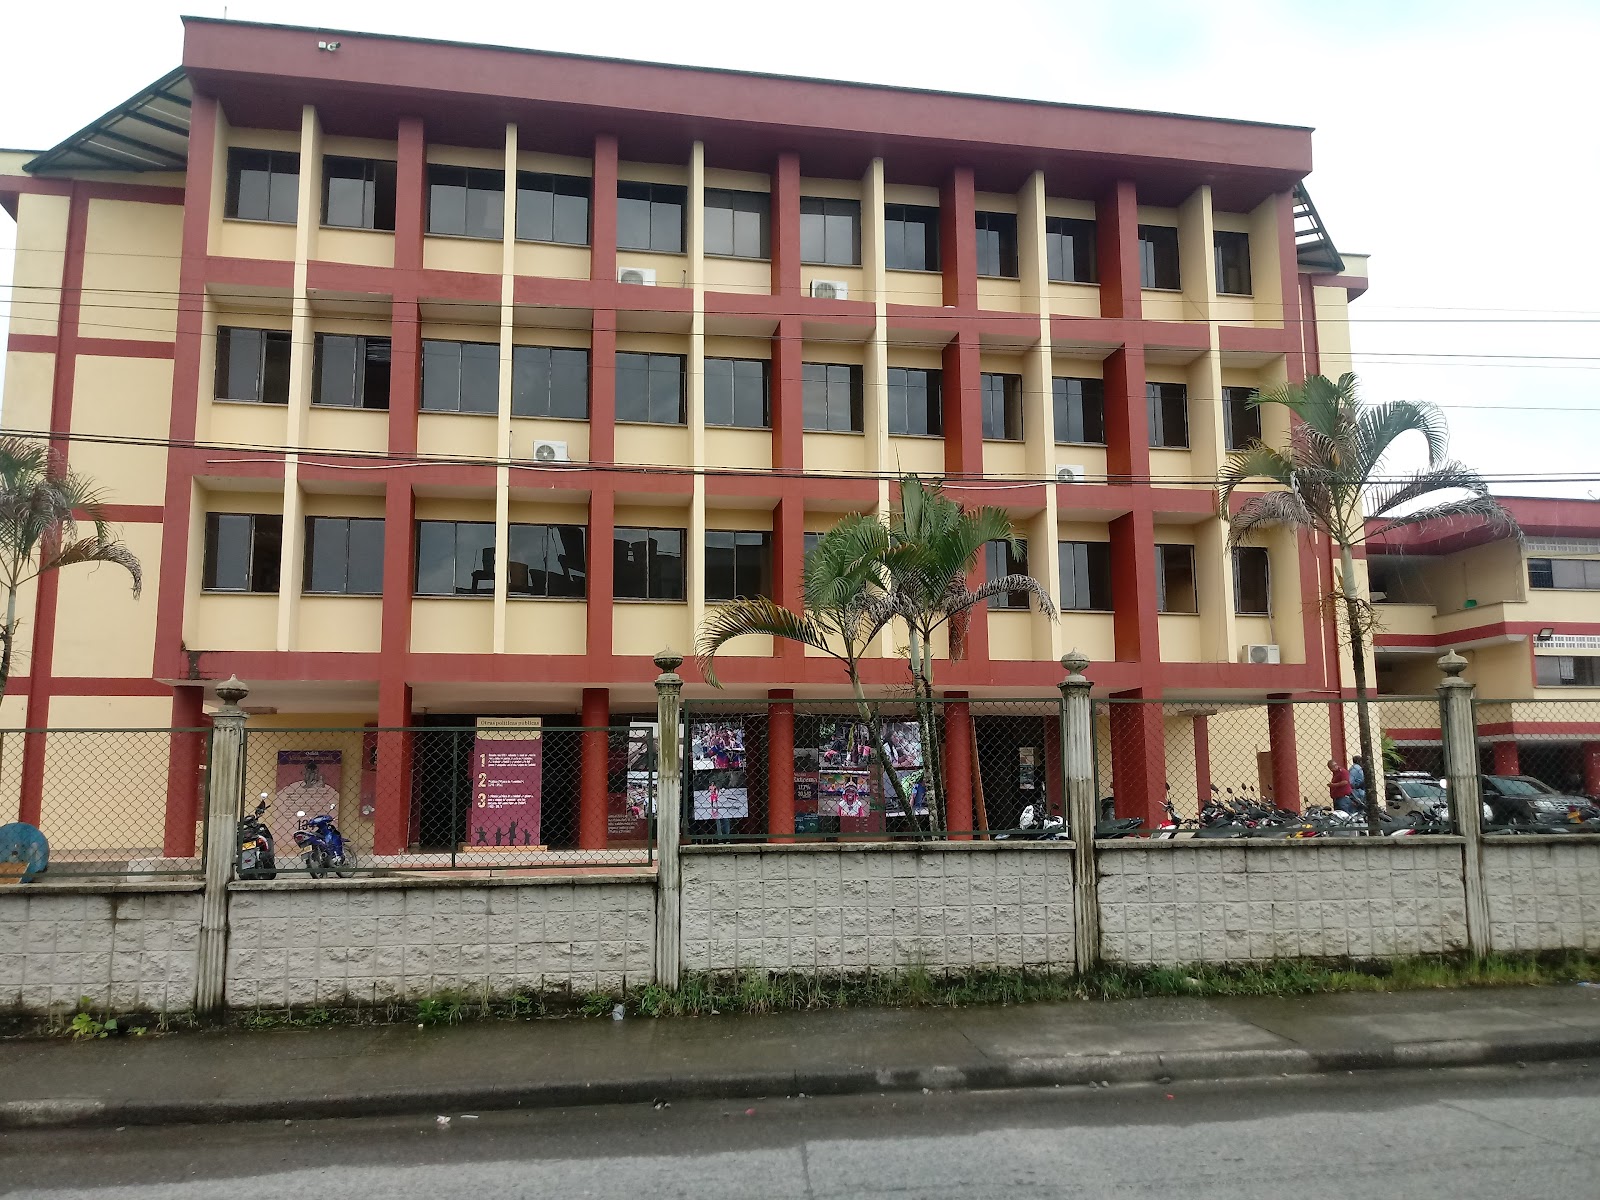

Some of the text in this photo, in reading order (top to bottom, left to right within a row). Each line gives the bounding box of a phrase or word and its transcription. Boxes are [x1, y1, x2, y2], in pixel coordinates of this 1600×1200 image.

[479, 753, 486, 768] 1
[478, 772, 487, 788] 2
[477, 793, 486, 808] 3
